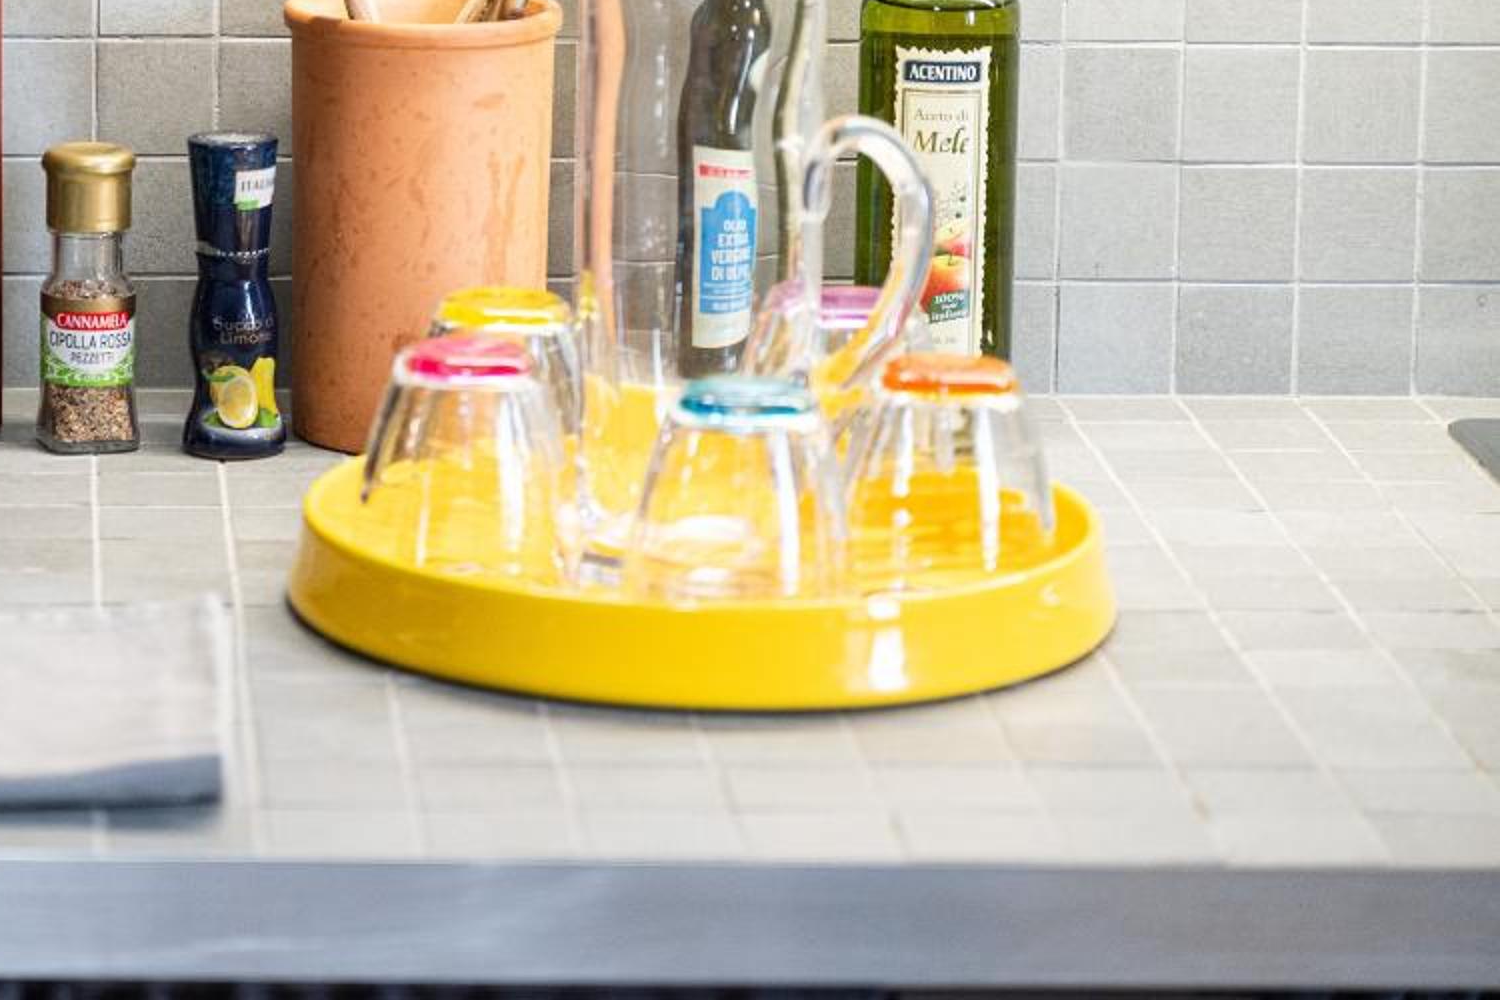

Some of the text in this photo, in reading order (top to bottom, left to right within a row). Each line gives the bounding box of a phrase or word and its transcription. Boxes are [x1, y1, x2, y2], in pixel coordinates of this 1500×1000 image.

[909, 63, 977, 81] ACENTINO
[914, 107, 969, 121] Aceto di
[913, 126, 970, 153] Mele
[57, 312, 128, 329] CANNAMELA
[49, 331, 97, 349] CIPOLLA
